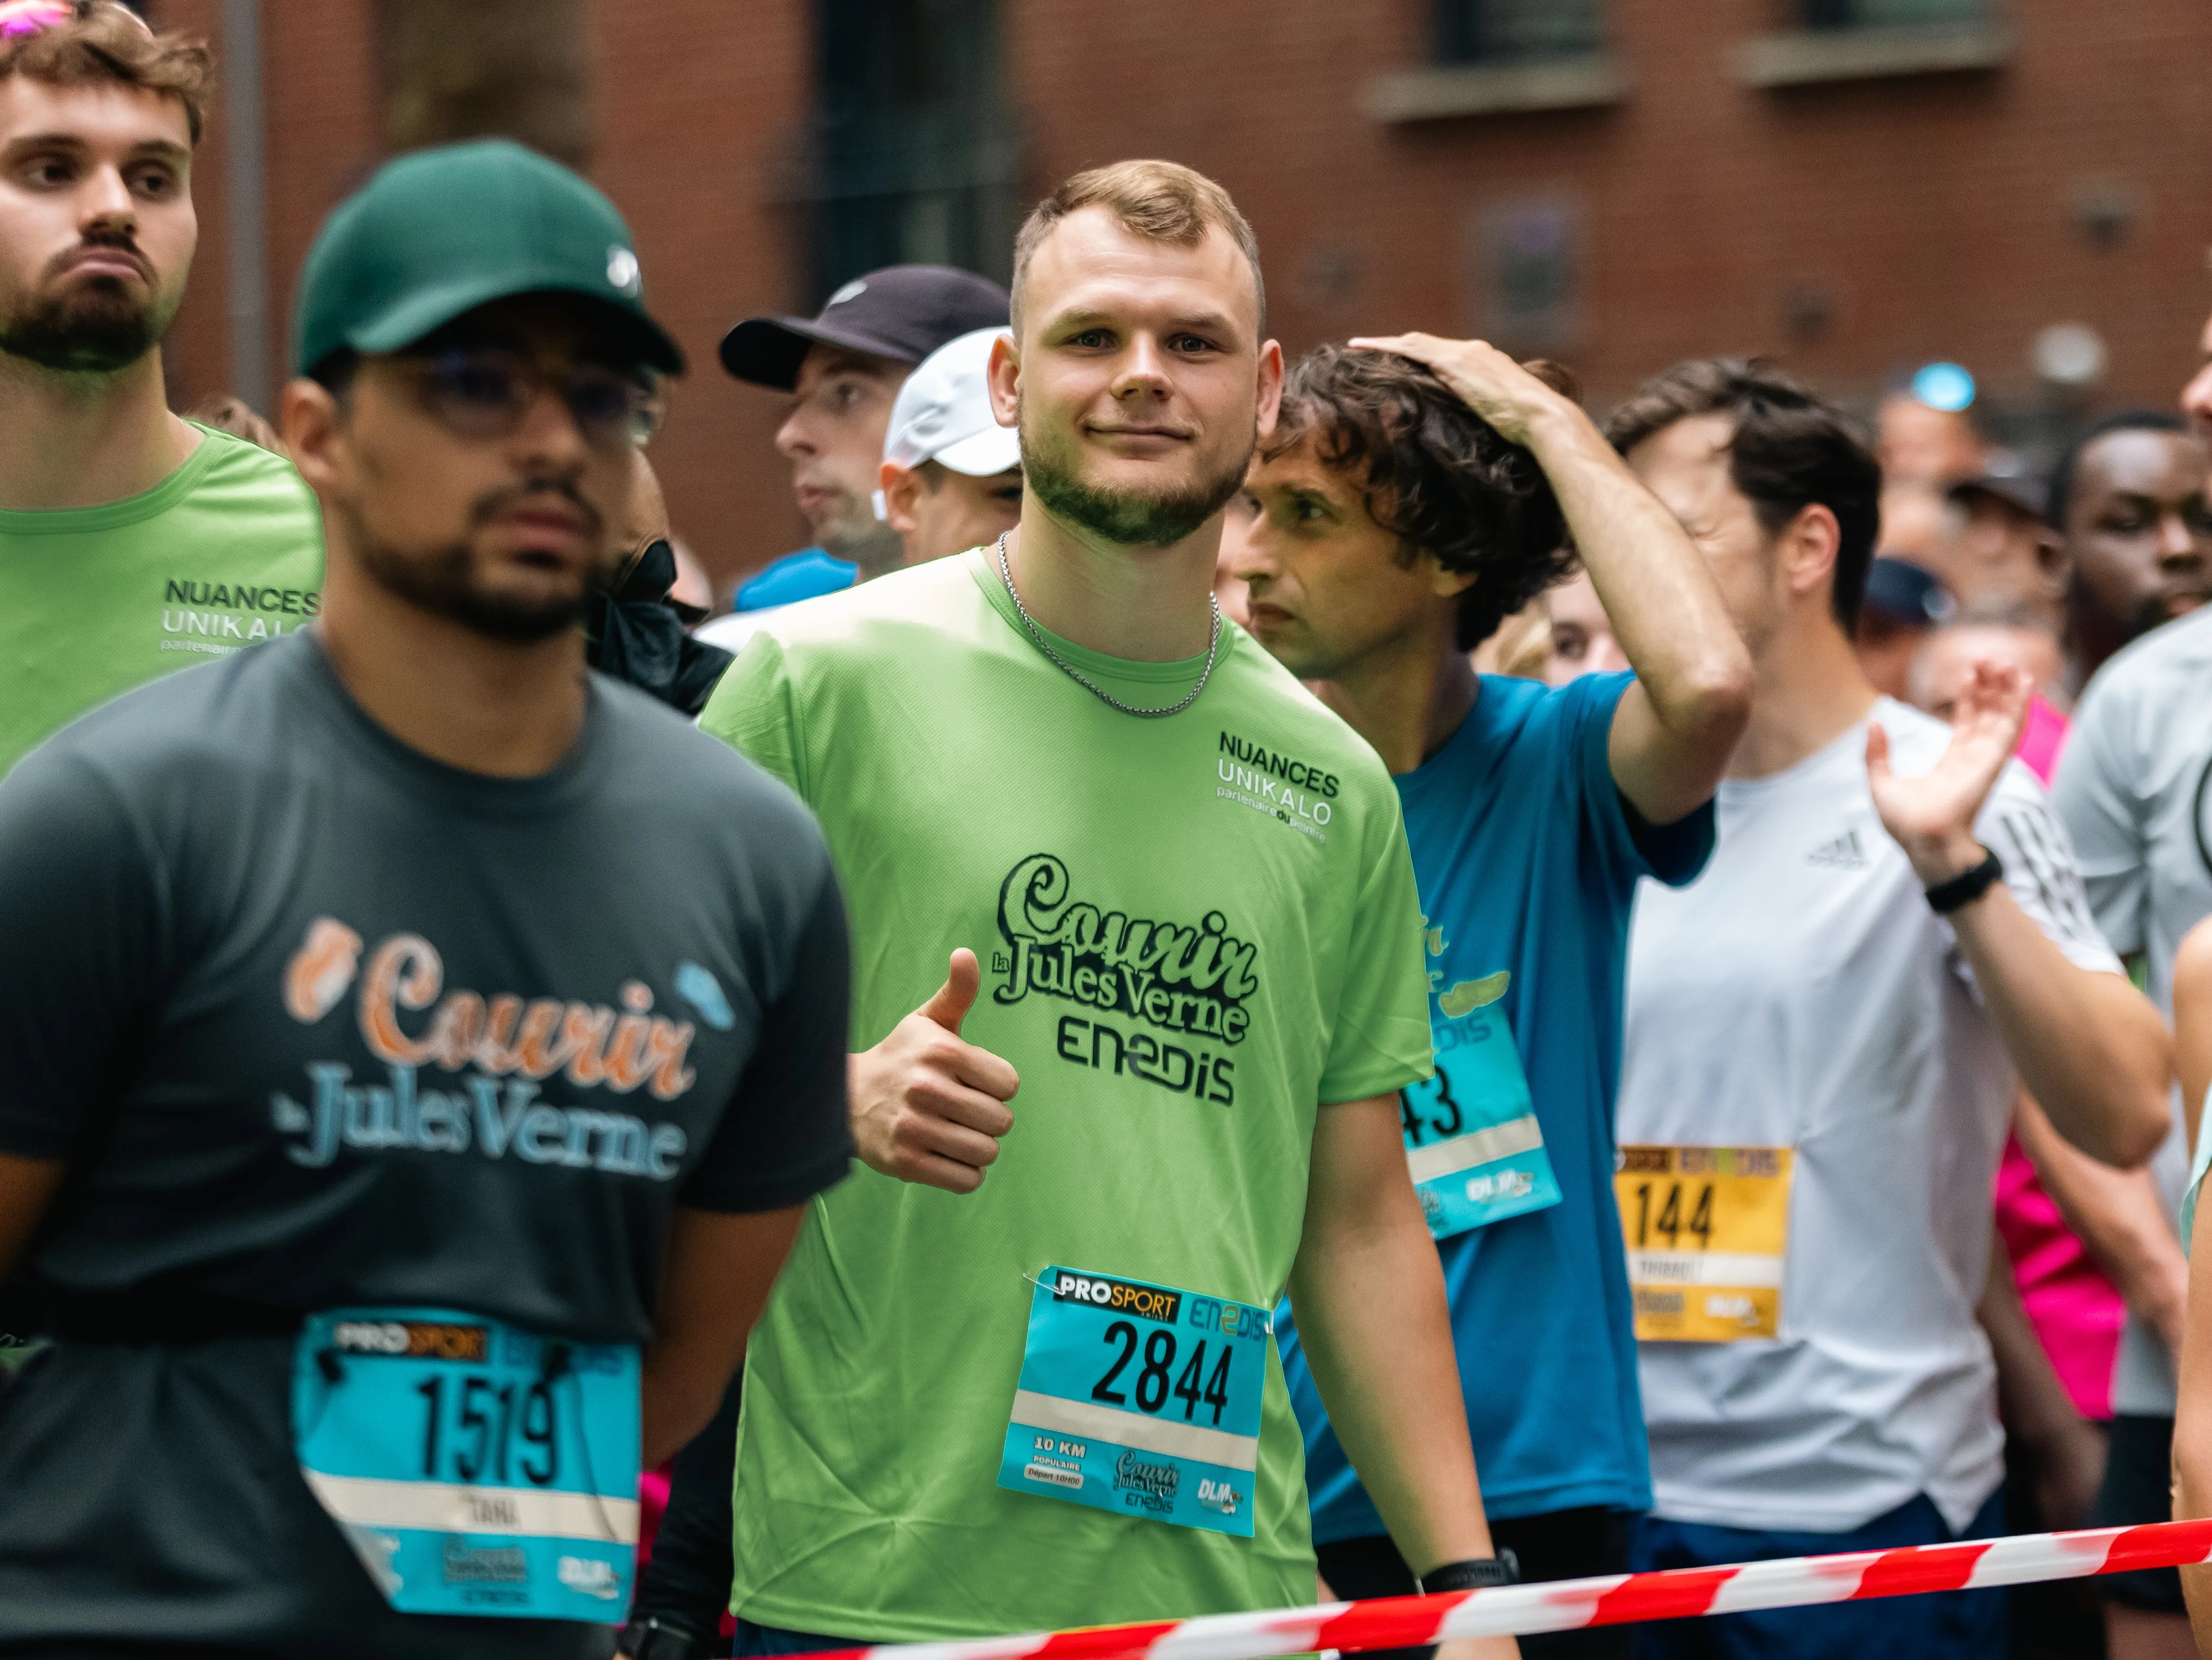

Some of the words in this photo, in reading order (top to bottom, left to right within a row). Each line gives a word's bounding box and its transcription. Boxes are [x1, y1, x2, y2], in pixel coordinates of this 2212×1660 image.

[162, 609, 283, 641] UNIKA
[166, 579, 323, 617] NUANCES
[1218, 758, 1332, 825] UNIKALO
[1219, 731, 1340, 799] NUANCES
[998, 853, 1257, 999] Courir
[357, 931, 697, 1101] Courir
[1636, 1181, 1715, 1250] 144
[1091, 1320, 1233, 1427] 2844
[416, 1375, 559, 1485] 1519
[1033, 1454, 1081, 1472] POPULAIRE
[1034, 1436, 1055, 1451] 10
[1058, 1440, 1087, 1459] KM
